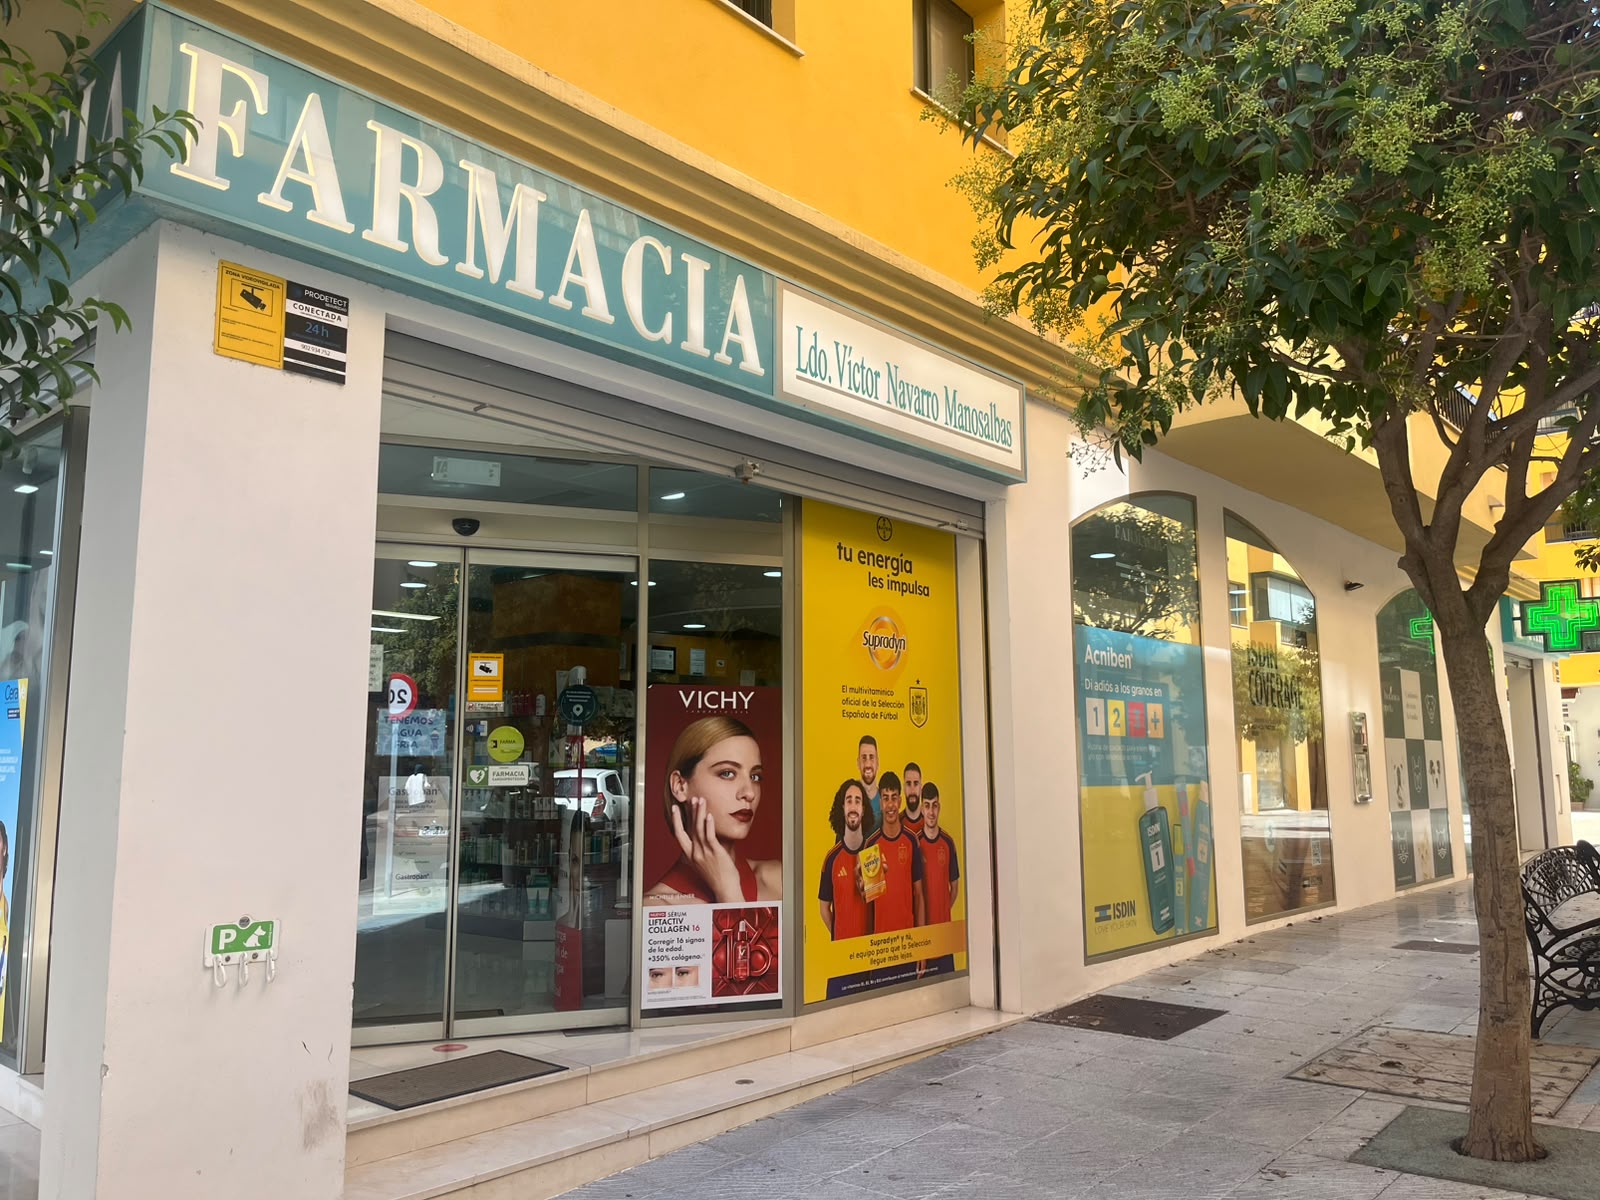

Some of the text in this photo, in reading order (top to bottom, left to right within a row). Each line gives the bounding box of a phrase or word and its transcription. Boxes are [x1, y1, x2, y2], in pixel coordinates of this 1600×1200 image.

[170, 42, 765, 376] FARMACIA
[225, 269, 240, 278] ZONA
[304, 289, 347, 307] PRODETECT
[293, 302, 342, 322] CONECTADA
[796, 325, 1012, 448] Ldo. Víctor Navarro Manosalbas
[836, 542, 912, 576] tu energía
[868, 572, 930, 597] les impulsa
[863, 631, 906, 653] Supradyn
[842, 685, 847, 693] El
[1085, 678, 1162, 697] Di adiós a los granos en
[1248, 670, 1304, 710] COVERAGE
[679, 690, 754, 709] VICHY
[842, 697, 904, 709] oficial de la Selección
[384, 715, 434, 726] TENEMOS
[842, 709, 869, 719] Española
[871, 711, 878, 719] de
[1093, 705, 1098, 727] 1
[1113, 708, 1121, 728] 2
[1113, 900, 1136, 919] ISDIN
[648, 918, 684, 926] LIFTACTIV
[648, 925, 689, 933] COLLAGEN
[219, 929, 237, 950] P
[648, 938, 674, 946] Corregir
[685, 937, 705, 945] signos
[856, 950, 875, 960] equipo
[870, 957, 887, 966] llegue
